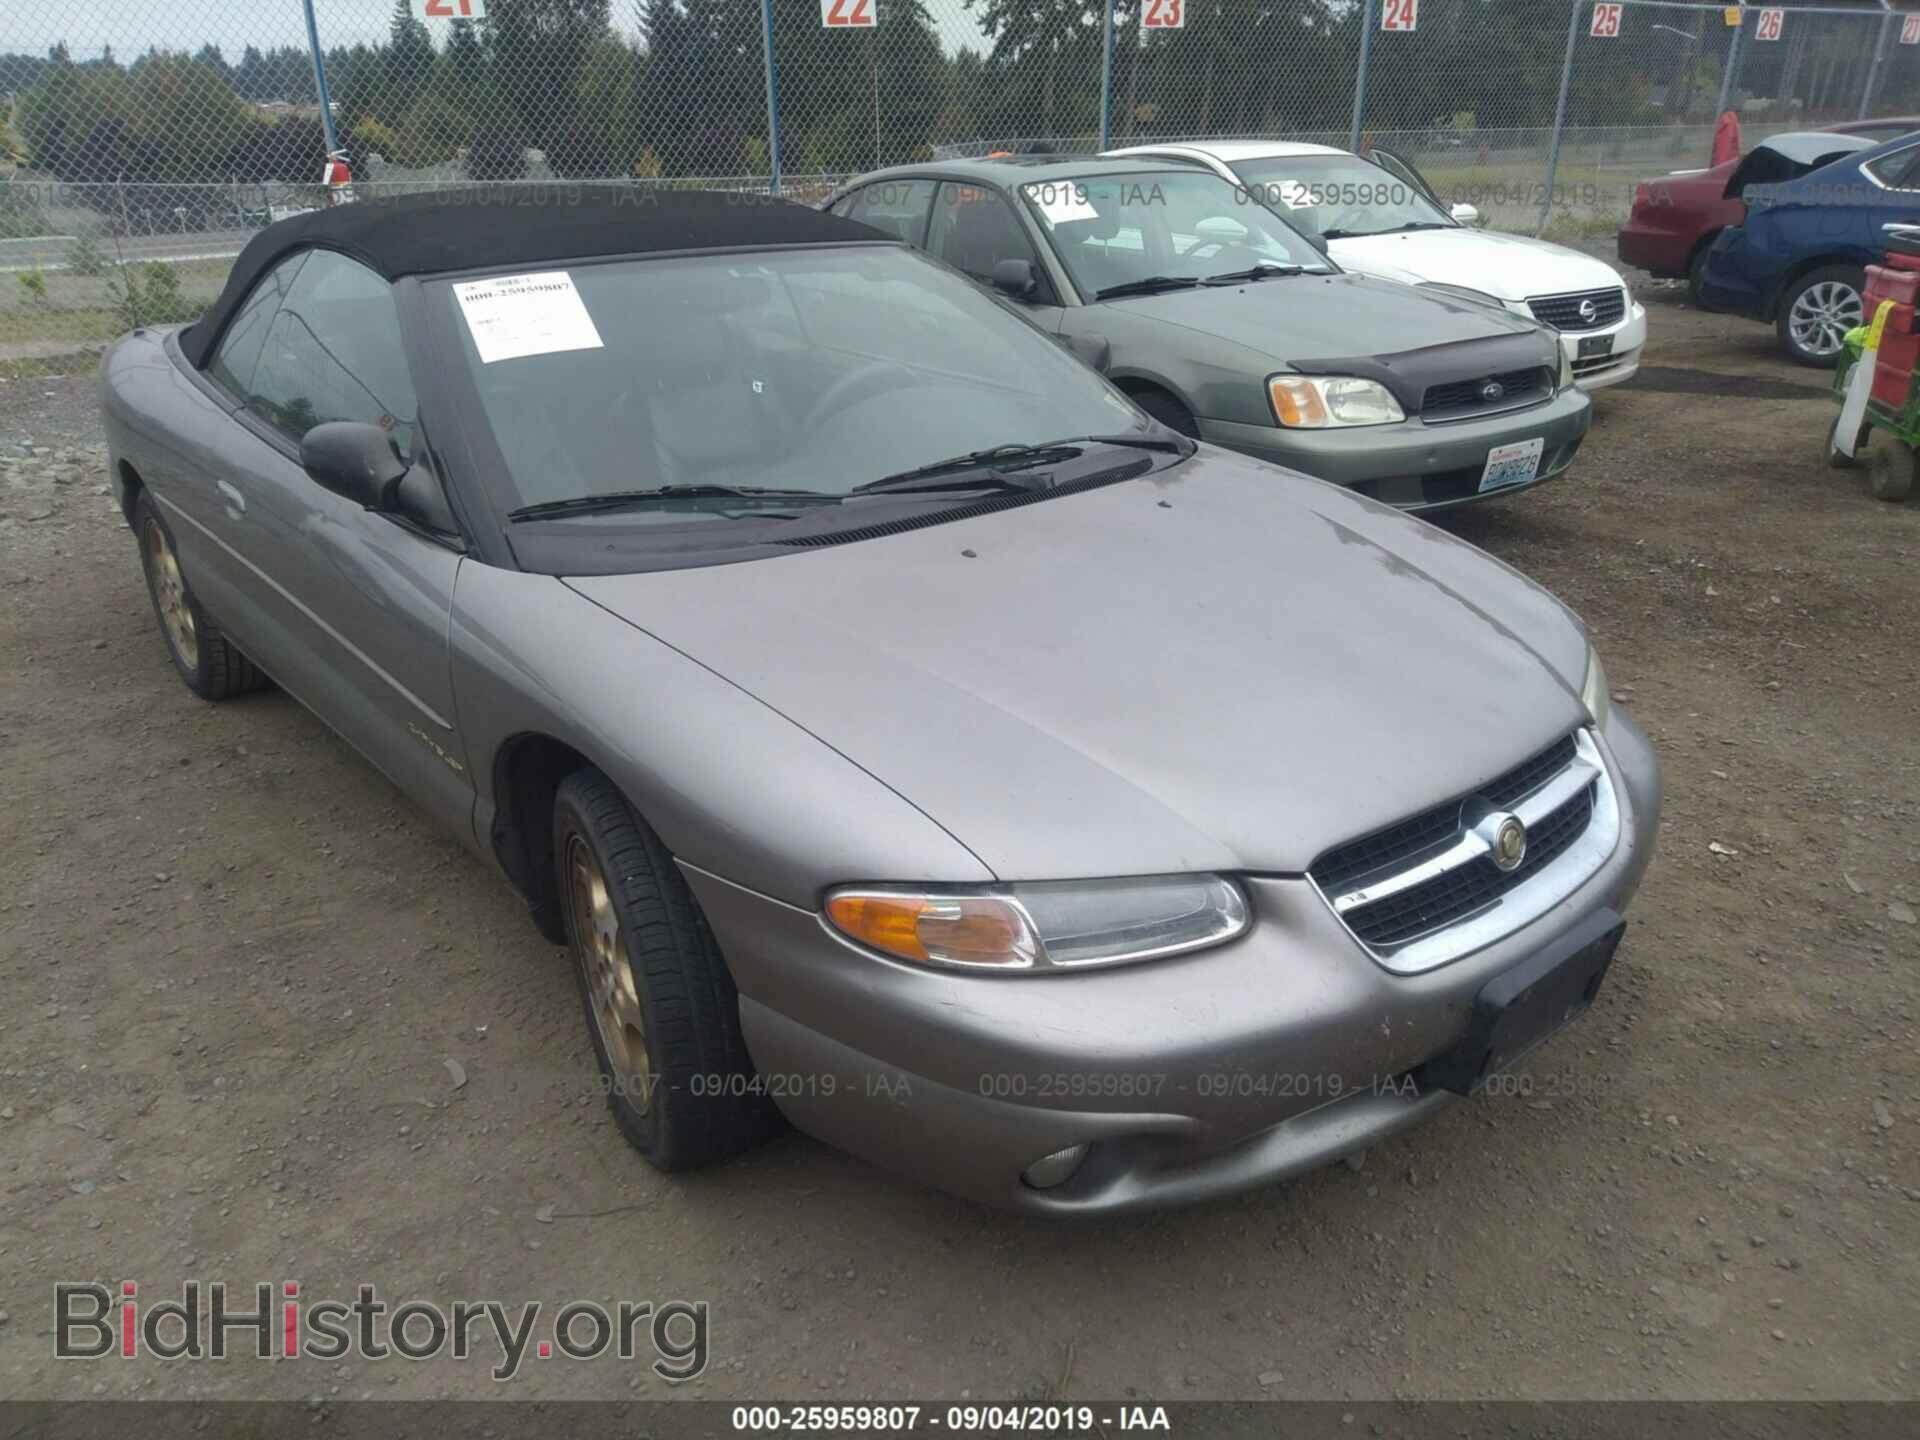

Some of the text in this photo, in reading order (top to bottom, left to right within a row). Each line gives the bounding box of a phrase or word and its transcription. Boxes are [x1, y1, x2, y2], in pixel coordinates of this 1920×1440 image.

[1144, 0, 1180, 26] 23
[1384, 0, 1415, 29] 24
[1593, 5, 1620, 35] 25
[1759, 12, 1782, 39] 26
